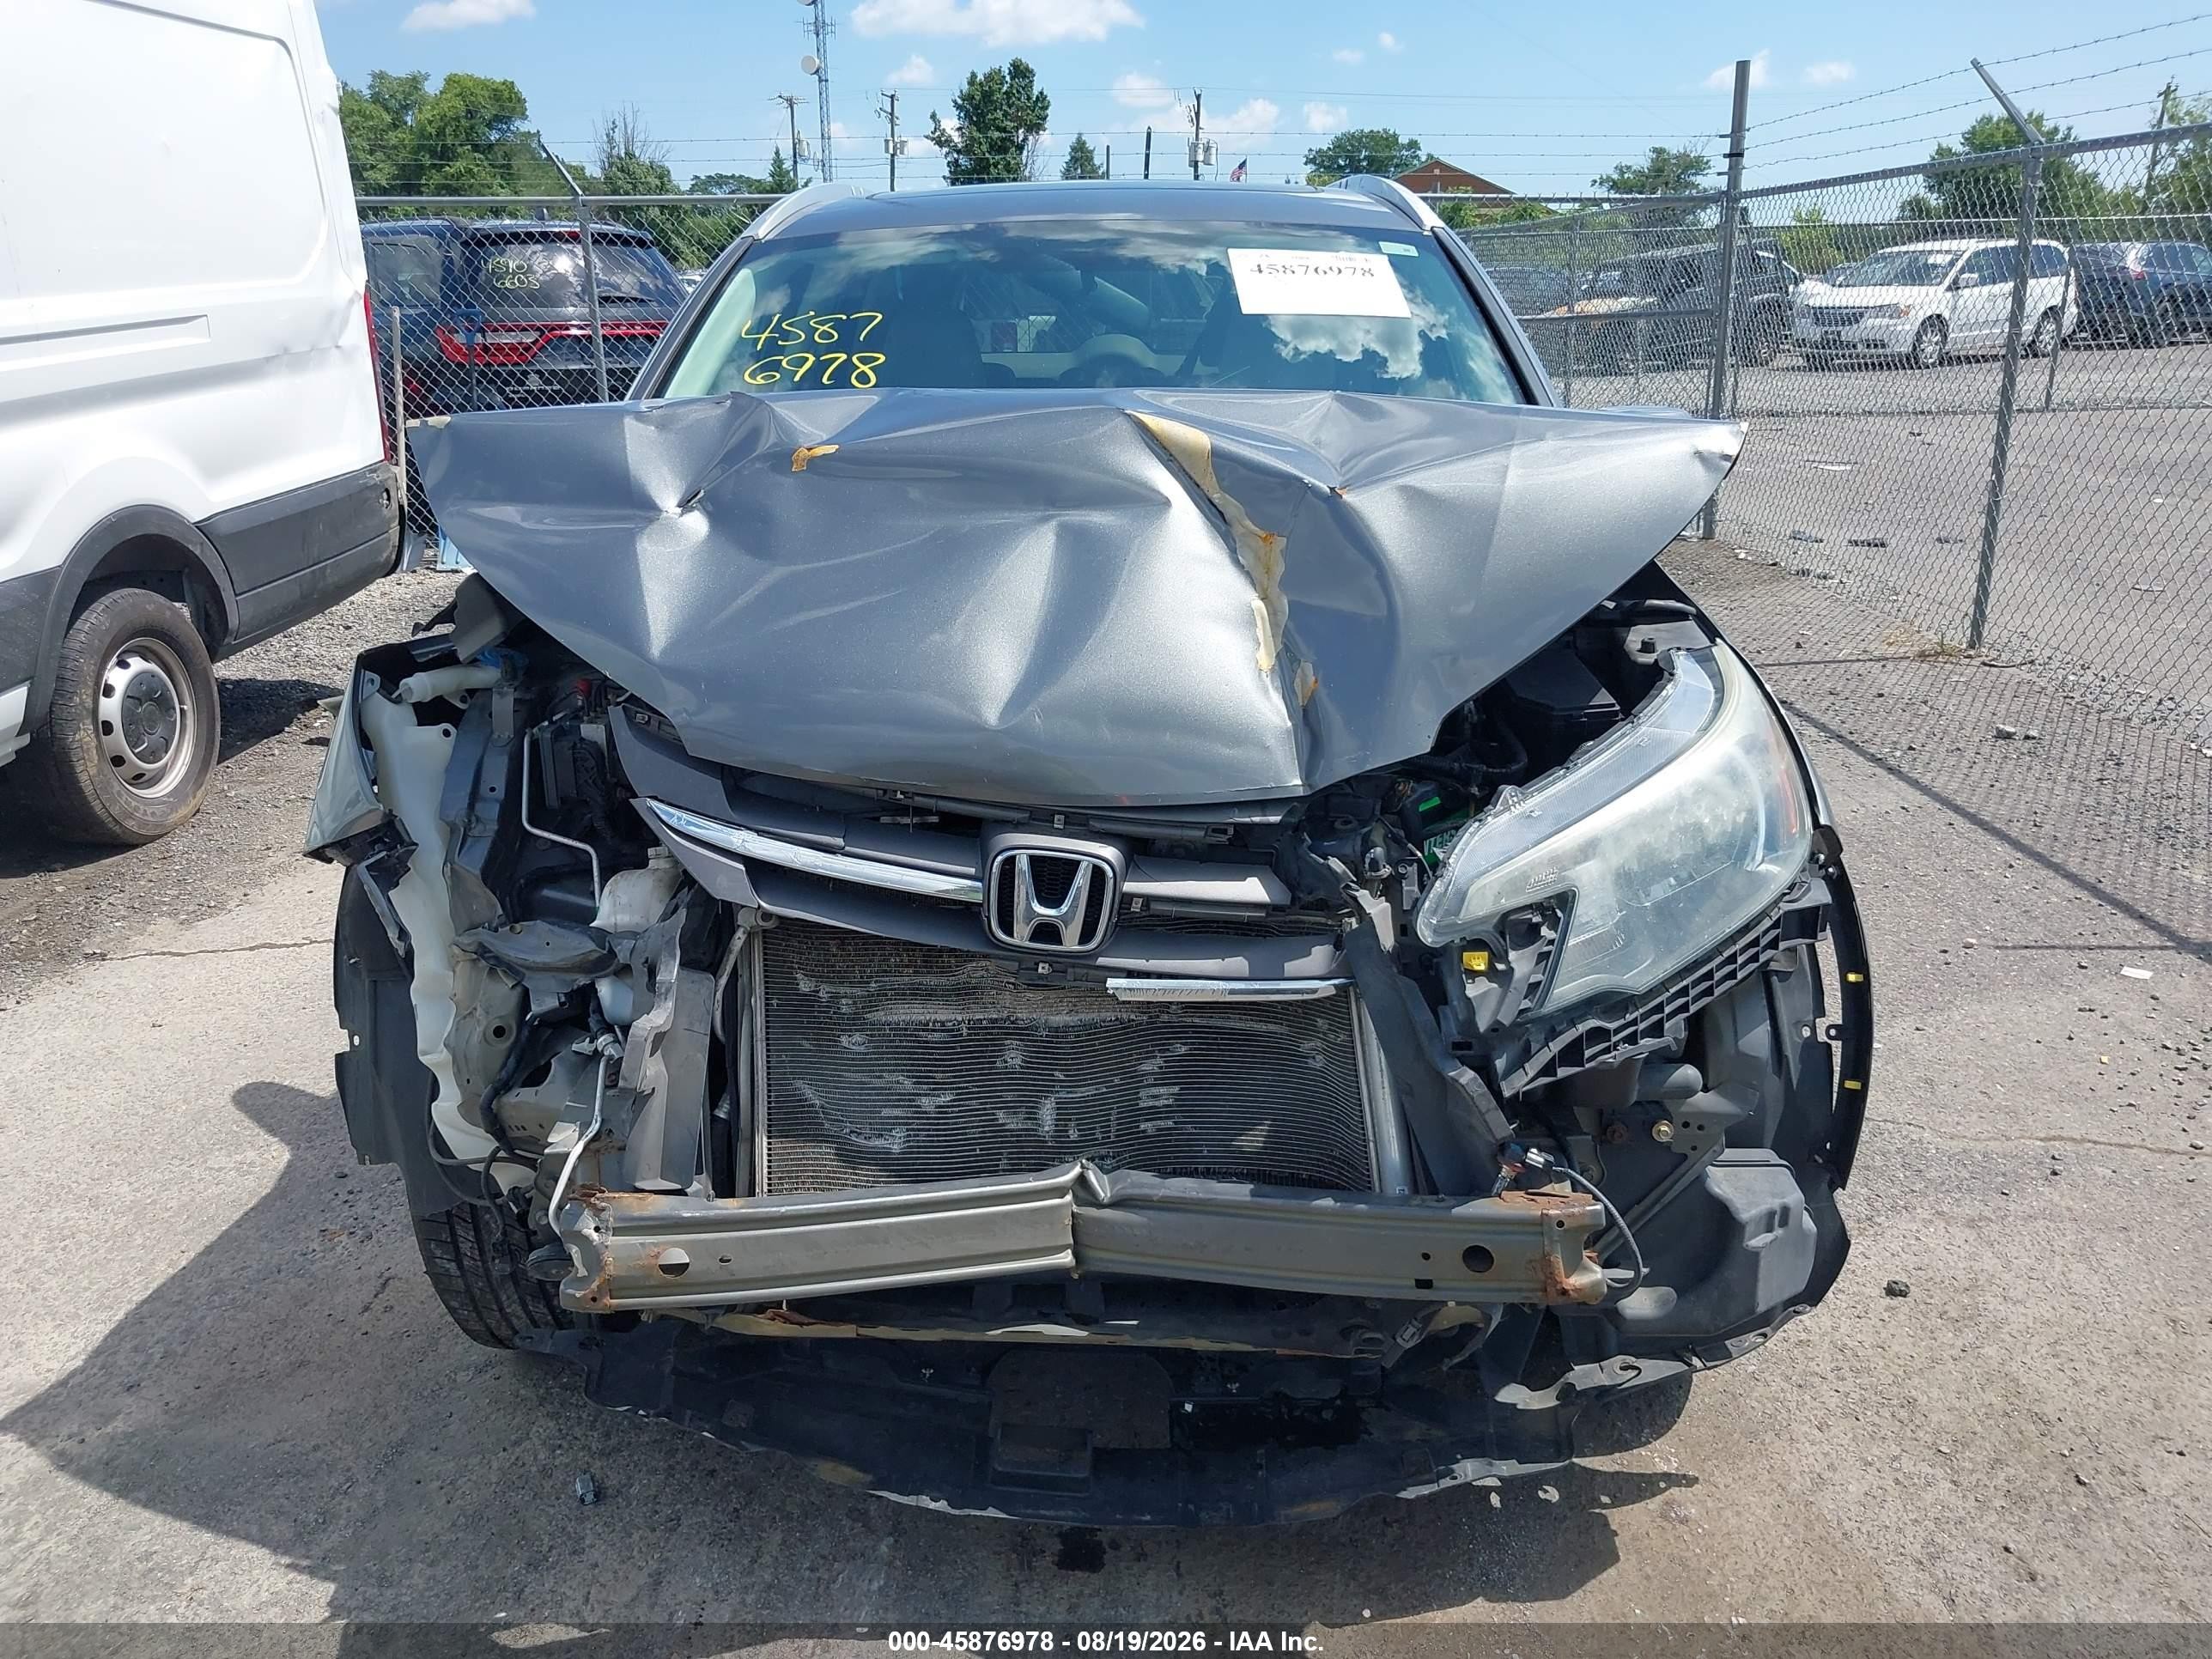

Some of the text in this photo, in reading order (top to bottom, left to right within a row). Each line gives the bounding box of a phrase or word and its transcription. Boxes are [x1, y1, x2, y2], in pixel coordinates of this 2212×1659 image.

[493, 273, 540, 289] 6603
[1249, 263, 1376, 277] 45876978
[740, 310, 884, 351] 4587
[743, 352, 886, 388] 6978
